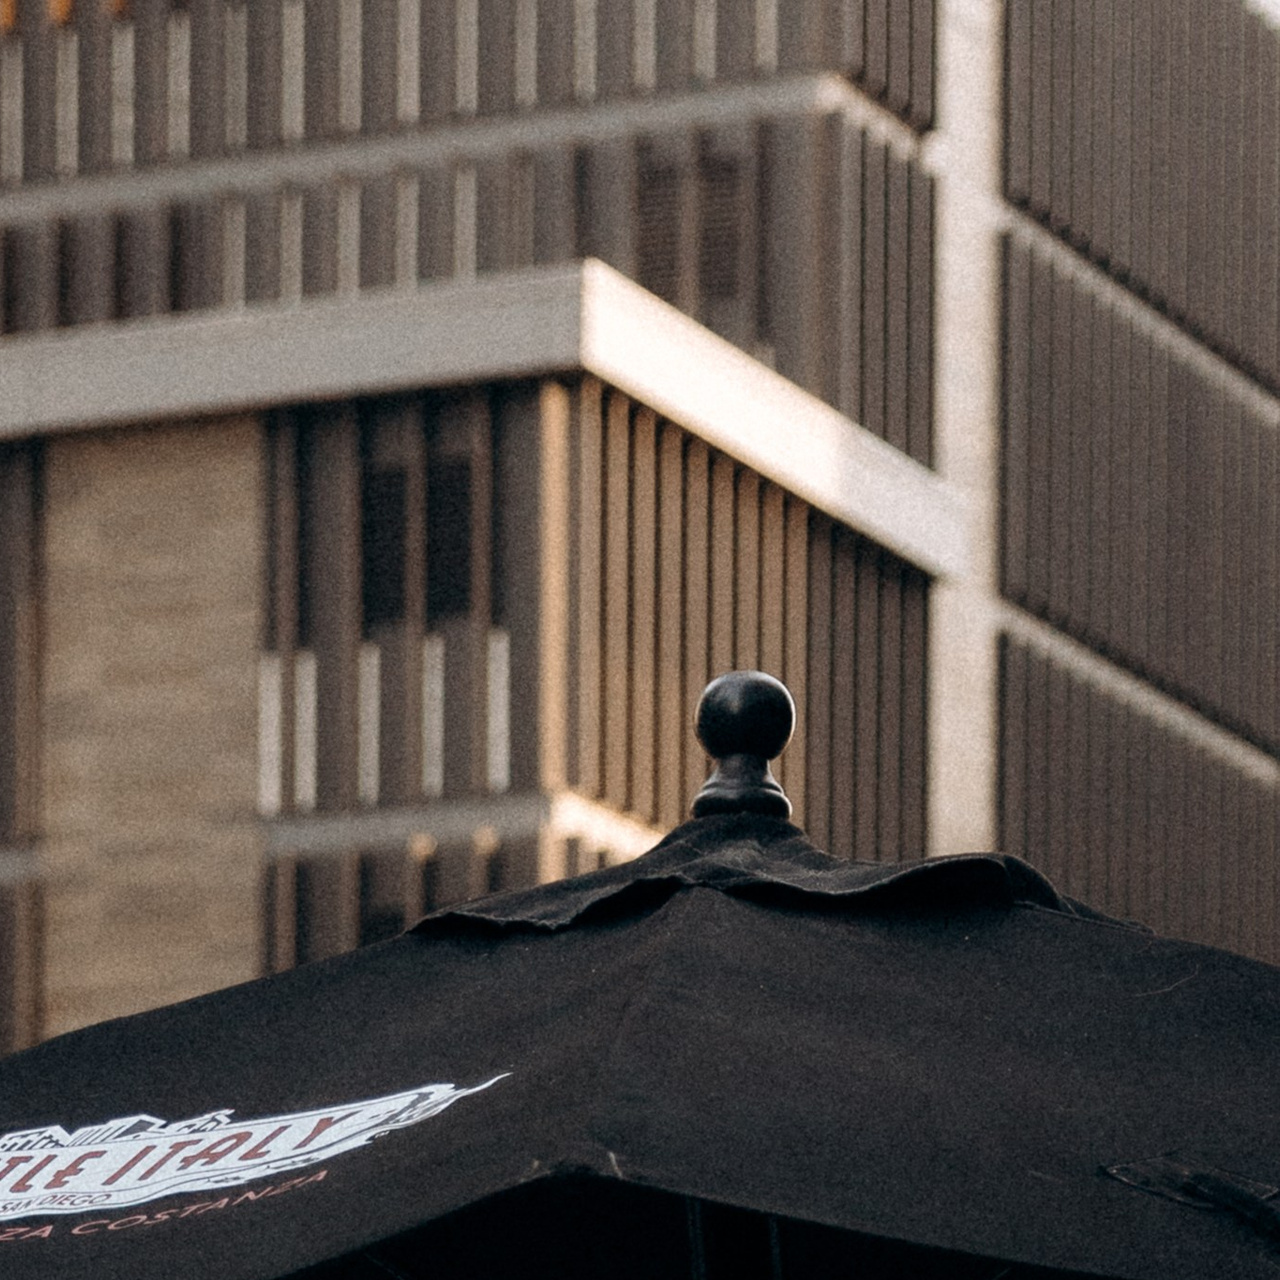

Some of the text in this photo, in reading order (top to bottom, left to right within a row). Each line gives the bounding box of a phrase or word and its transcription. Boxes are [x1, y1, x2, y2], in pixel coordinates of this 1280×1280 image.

[100, 1109, 363, 1187] ITALY
[41, 1193, 113, 1208] DIEGO
[70, 1169, 328, 1236] COSTANZA
